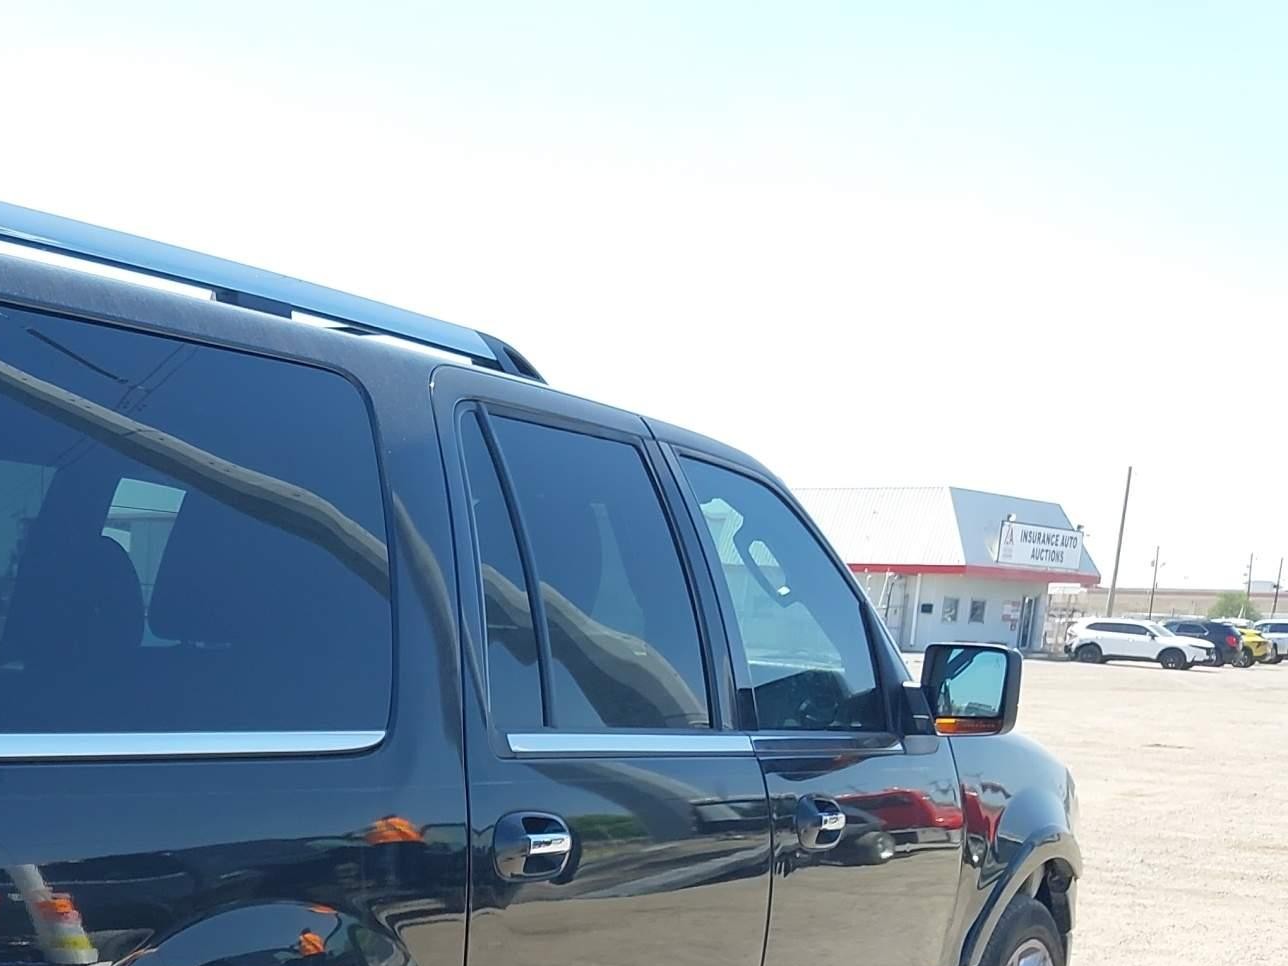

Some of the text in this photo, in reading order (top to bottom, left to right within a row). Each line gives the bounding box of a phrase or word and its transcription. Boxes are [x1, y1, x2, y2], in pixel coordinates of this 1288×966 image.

[1020, 529, 1059, 547] INSURANCE
[1061, 535, 1078, 549] AUTO
[1031, 548, 1064, 563] AUCTIONS
